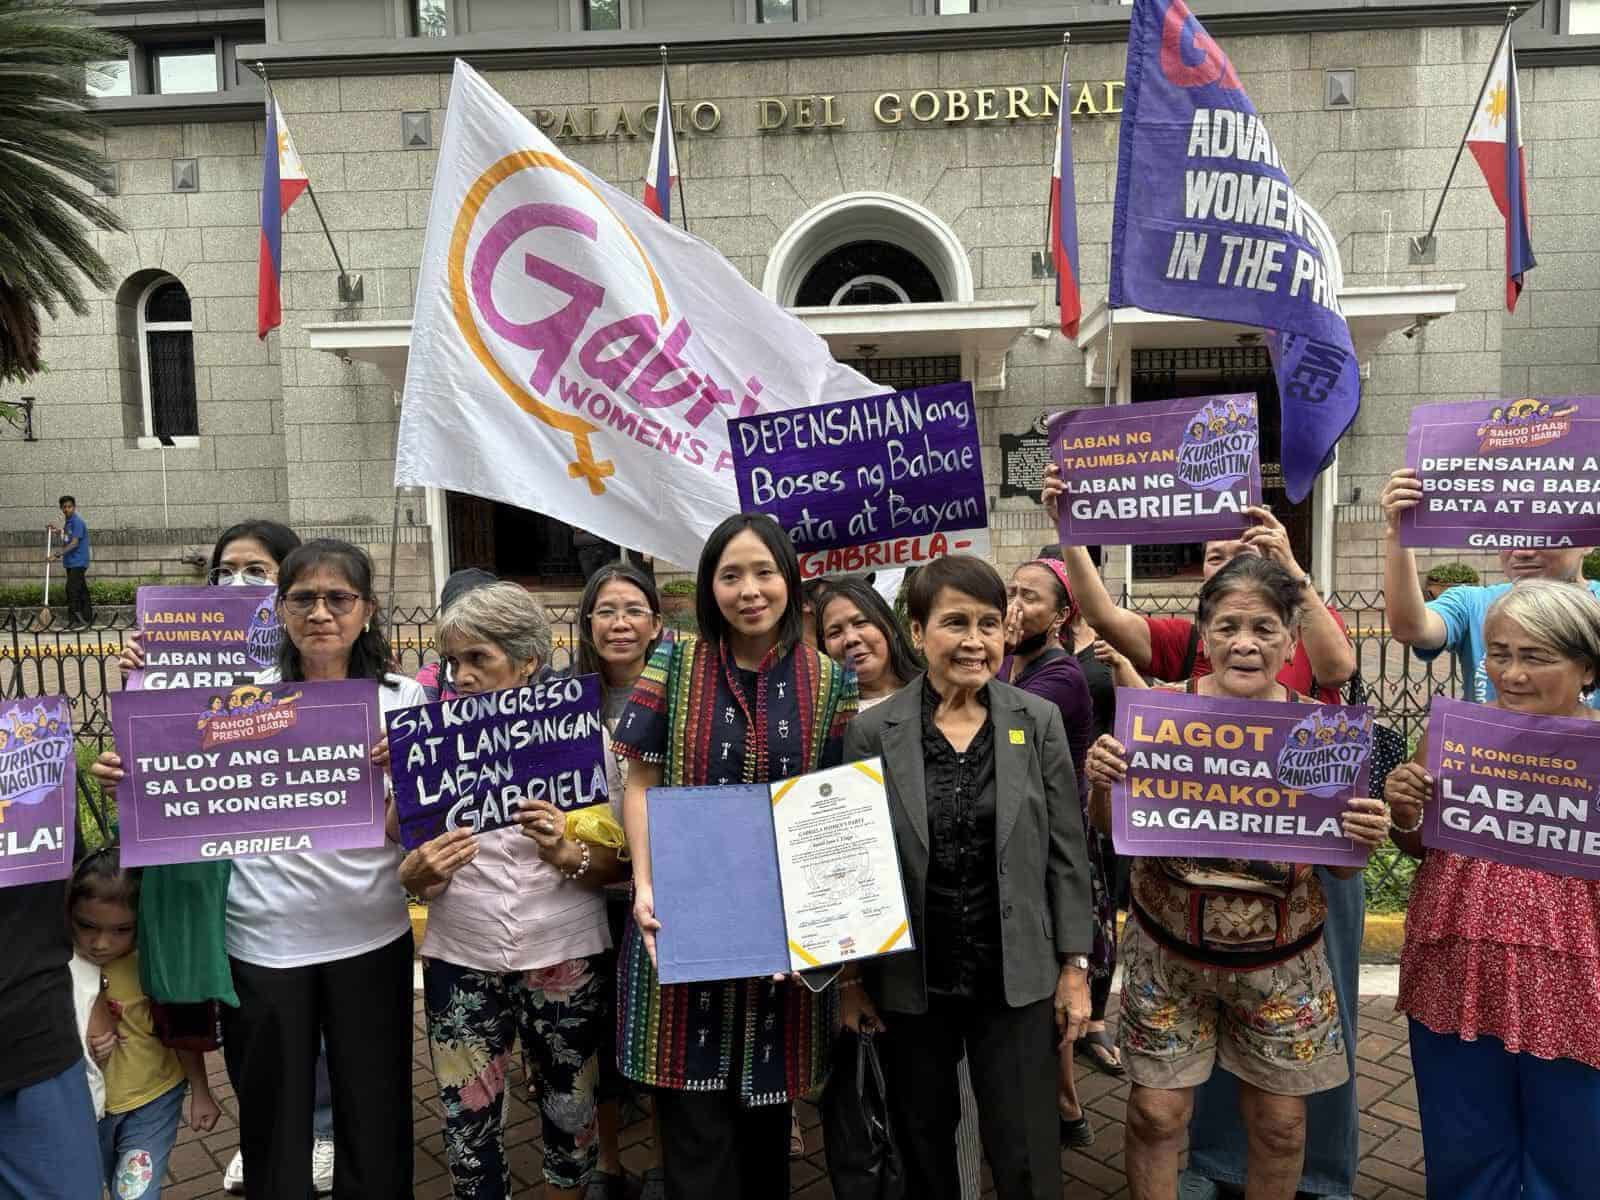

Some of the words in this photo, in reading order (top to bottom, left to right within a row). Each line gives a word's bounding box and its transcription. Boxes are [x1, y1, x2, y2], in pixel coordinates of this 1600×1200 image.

[531, 101, 721, 139] PALACIO
[757, 95, 846, 131] DEL
[1166, 232, 1208, 281] IN
[1217, 235, 1287, 293] THE
[560, 376, 708, 466] WOMEN'S
[738, 392, 923, 457] DEPENSAHAN
[926, 400, 969, 428] ang
[1490, 426, 1529, 438] SAHOD
[1063, 434, 1121, 451] LABAN
[1126, 431, 1152, 444] NG
[1182, 434, 1254, 462] KURAKOT
[1489, 435, 1529, 447] PRESYO
[751, 467, 846, 506] Boses
[857, 464, 886, 497] ng
[887, 435, 974, 481] Babae
[1179, 453, 1252, 483] PANAGUTIN
[1421, 456, 1574, 471] DEPENSAHAN
[1066, 476, 1137, 494] LABAN
[1143, 474, 1175, 490] NG
[1423, 479, 1495, 492] BOSES
[1502, 479, 1535, 492] NG
[765, 508, 838, 545] ata
[848, 500, 877, 537] at
[889, 490, 979, 533] Bayan
[1071, 489, 1249, 520] GABRIELA!
[1429, 498, 1488, 513] BATA
[1494, 500, 1525, 513] AT
[1531, 500, 1600, 515] BAYA
[1468, 533, 1573, 547] GABRIELA
[144, 611, 196, 624] LABAN
[201, 611, 225, 623] NG
[146, 651, 211, 666] LABAN
[217, 652, 246, 665] NG
[212, 718, 254, 730] SAHOD
[391, 708, 433, 743] SA
[441, 678, 583, 729] KONGRESO
[212, 727, 254, 740] PRESYO
[407, 737, 445, 773] AT
[457, 709, 601, 761] LANSANGAN
[1133, 716, 1274, 752] LAGOT
[137, 752, 221, 773] TULOY
[228, 749, 280, 767] ANG
[287, 744, 365, 762] LABAN
[1130, 751, 1194, 772] ANG
[1203, 757, 1273, 779] MGA
[1283, 745, 1364, 767] KURAKOT
[1443, 740, 1466, 754] SA
[1471, 746, 1577, 770] KONGRESO
[145, 779, 179, 796] SA
[186, 774, 253, 793] LOOB
[261, 773, 280, 788] &
[286, 767, 361, 785] LABAS
[416, 755, 515, 806] LABAN
[1279, 763, 1360, 786] PANAGUTIN
[1442, 758, 1465, 771] AT
[1470, 764, 1593, 791] LANSANGAN,
[164, 801, 200, 817] NG
[208, 790, 347, 815] KONGRESO!
[1131, 777, 1305, 809] KURAKOT
[1442, 779, 1588, 822] LABAN
[1442, 806, 1600, 856] GABRIE
[201, 835, 313, 857] GABRIELA
